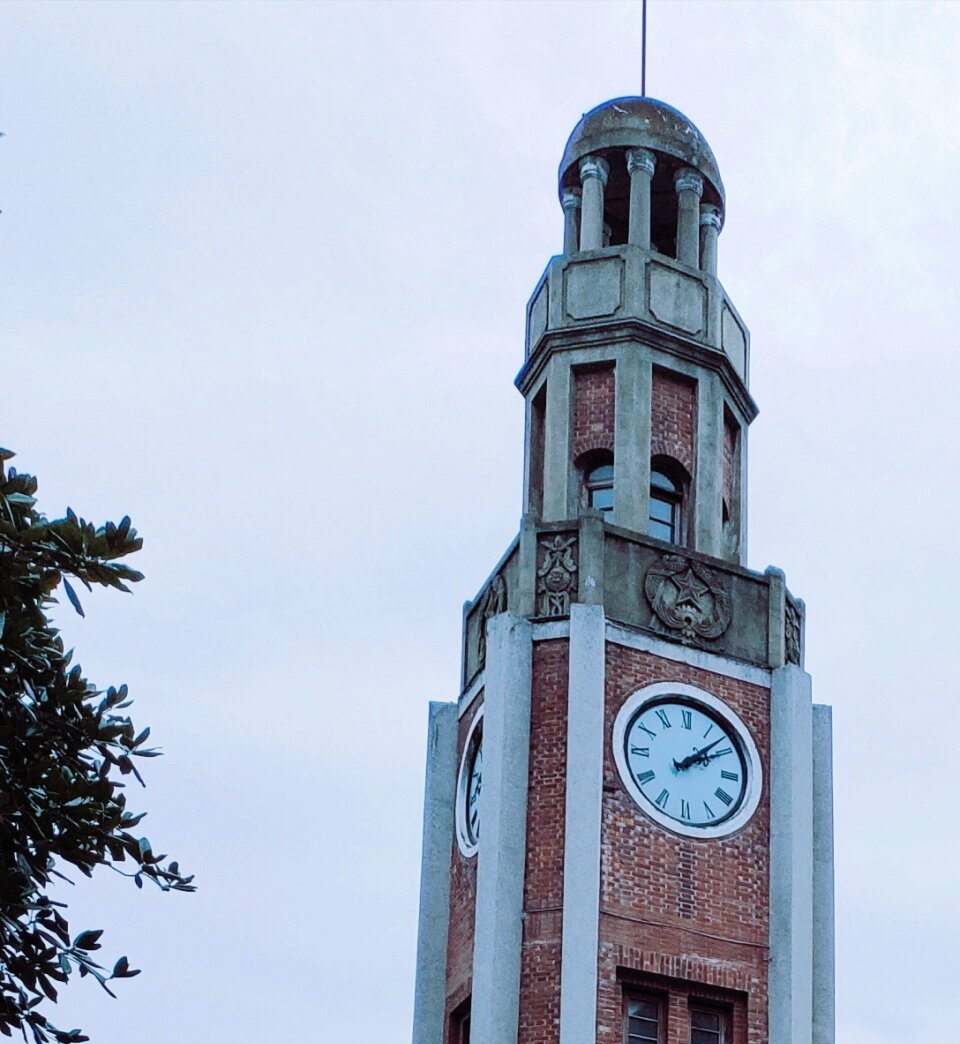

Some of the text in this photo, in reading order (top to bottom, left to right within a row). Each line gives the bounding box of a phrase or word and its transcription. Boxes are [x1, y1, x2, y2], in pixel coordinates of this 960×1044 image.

[655, 709, 672, 729] XI
[681, 710, 692, 730] XII
[638, 722, 657, 740] X
[703, 724, 713, 738] I
[631, 743, 649, 757] IX
[637, 770, 656, 785] VIII
[721, 770, 738, 782] III
[655, 788, 670, 808] VII
[681, 799, 691, 820] VI
[703, 800, 716, 819] V
